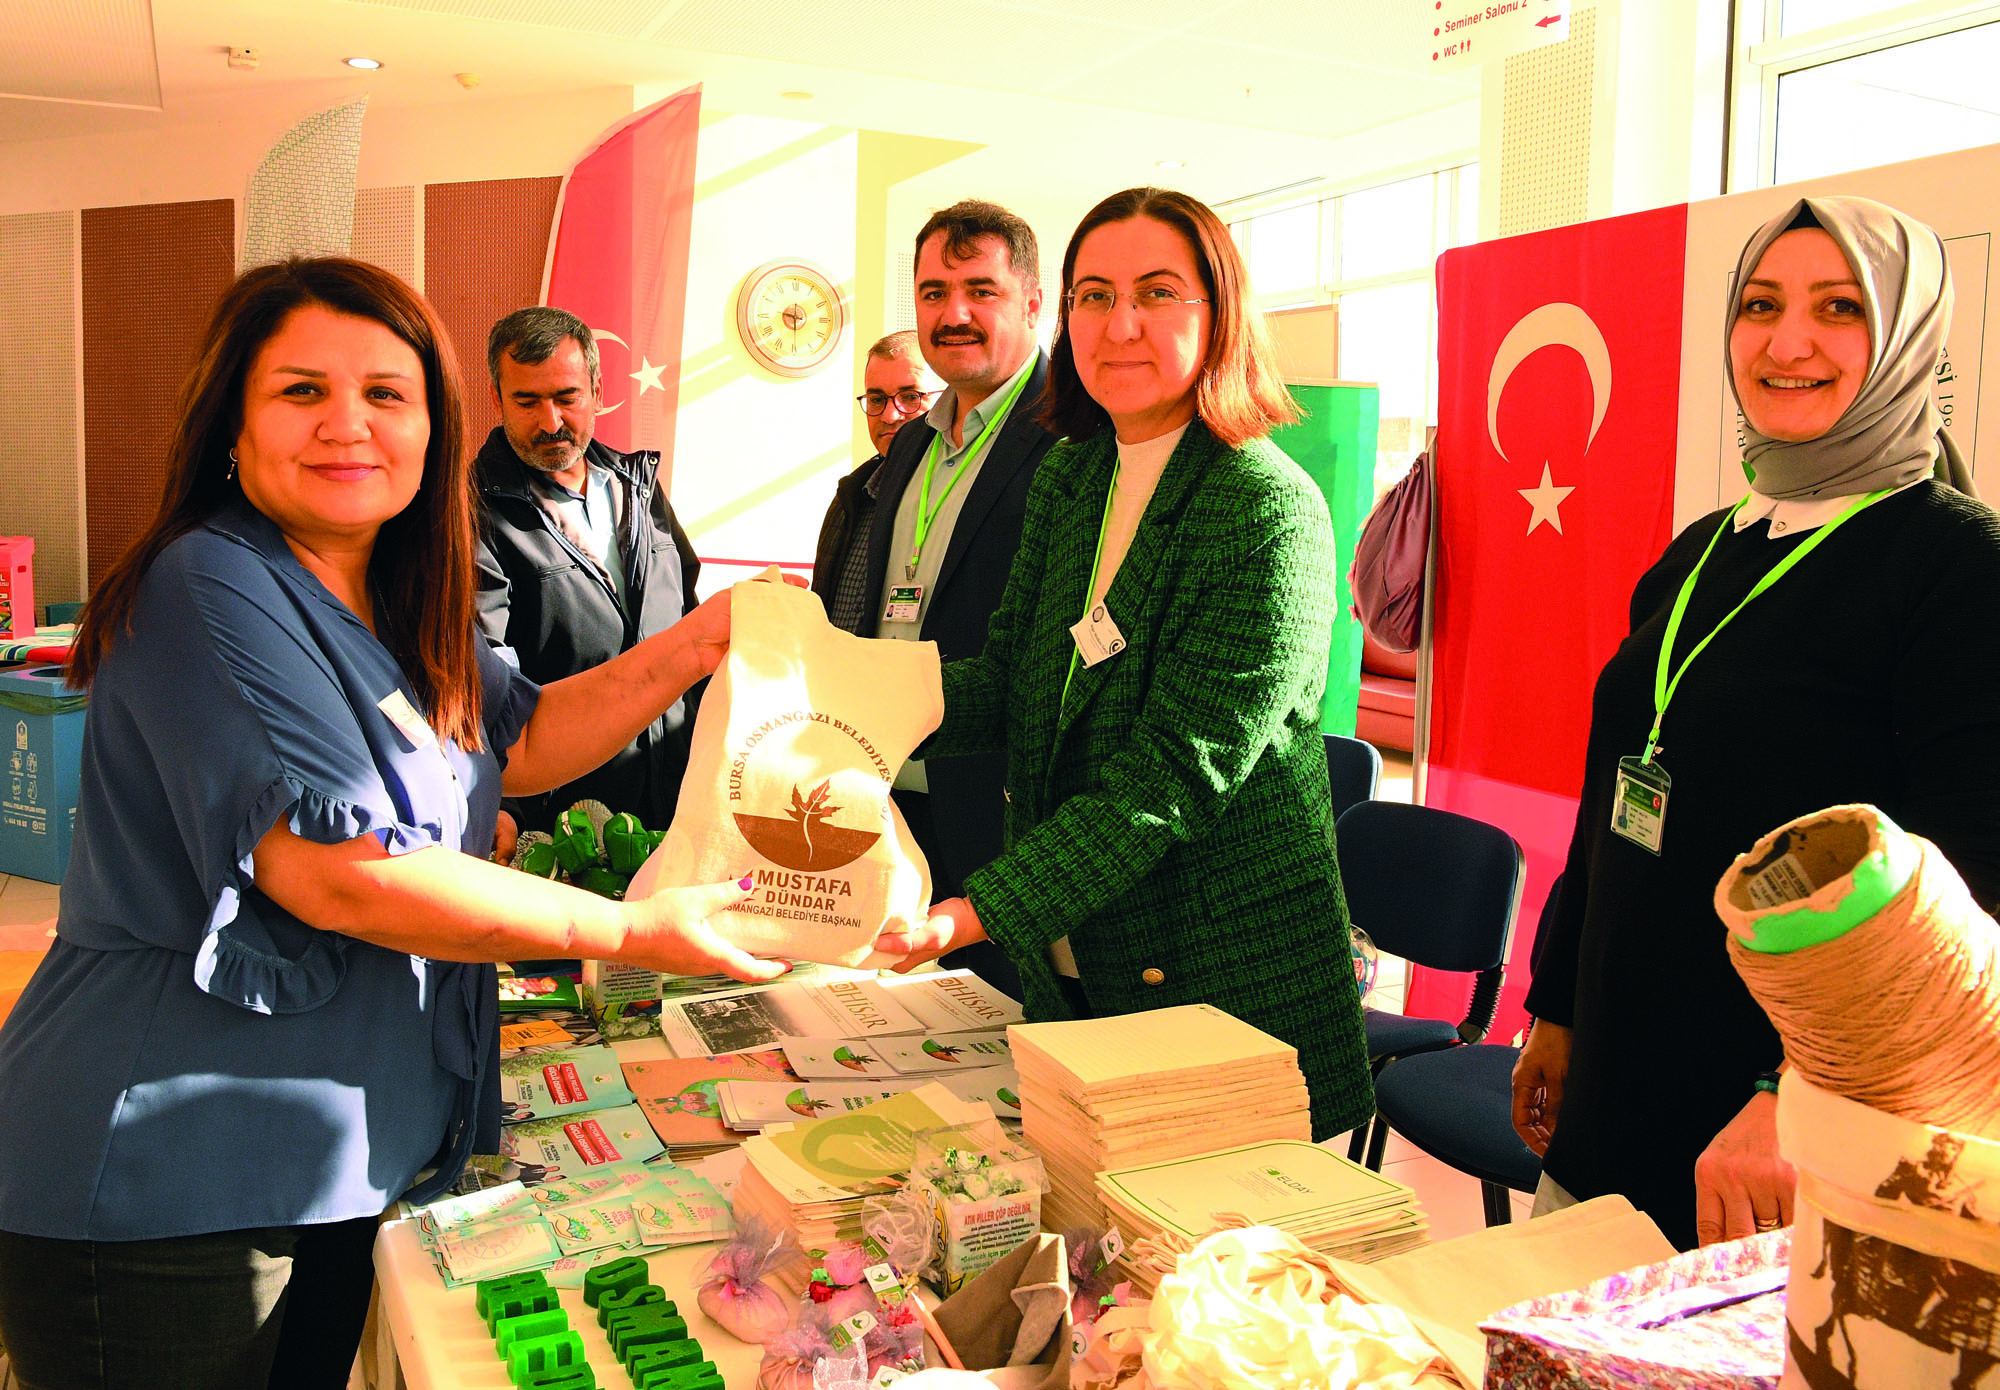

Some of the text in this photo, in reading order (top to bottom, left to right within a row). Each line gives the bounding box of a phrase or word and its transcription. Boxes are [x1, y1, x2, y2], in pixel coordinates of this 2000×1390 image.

[1444, 12, 1483, 33] Seminer
[1485, 1, 1519, 20] Salonu
[1443, 44, 1457, 58] WC
[729, 710, 893, 801] BURSA OSMANGAZİ BELEDİYES
[757, 869, 852, 897] MUSTAFA
[765, 889, 836, 911] DÜNDAR
[722, 903, 862, 928] SMANGAZİ BELEDİYE BAŞKANI
[836, 992, 888, 1030] HİSAR
[944, 985, 1005, 1021] HİSAR
[1276, 1175, 1316, 1194] ELDAY
[964, 1214, 976, 1225] ATIK
[976, 1210, 995, 1224] PİLLER
[995, 1205, 1007, 1221] ÇÖP
